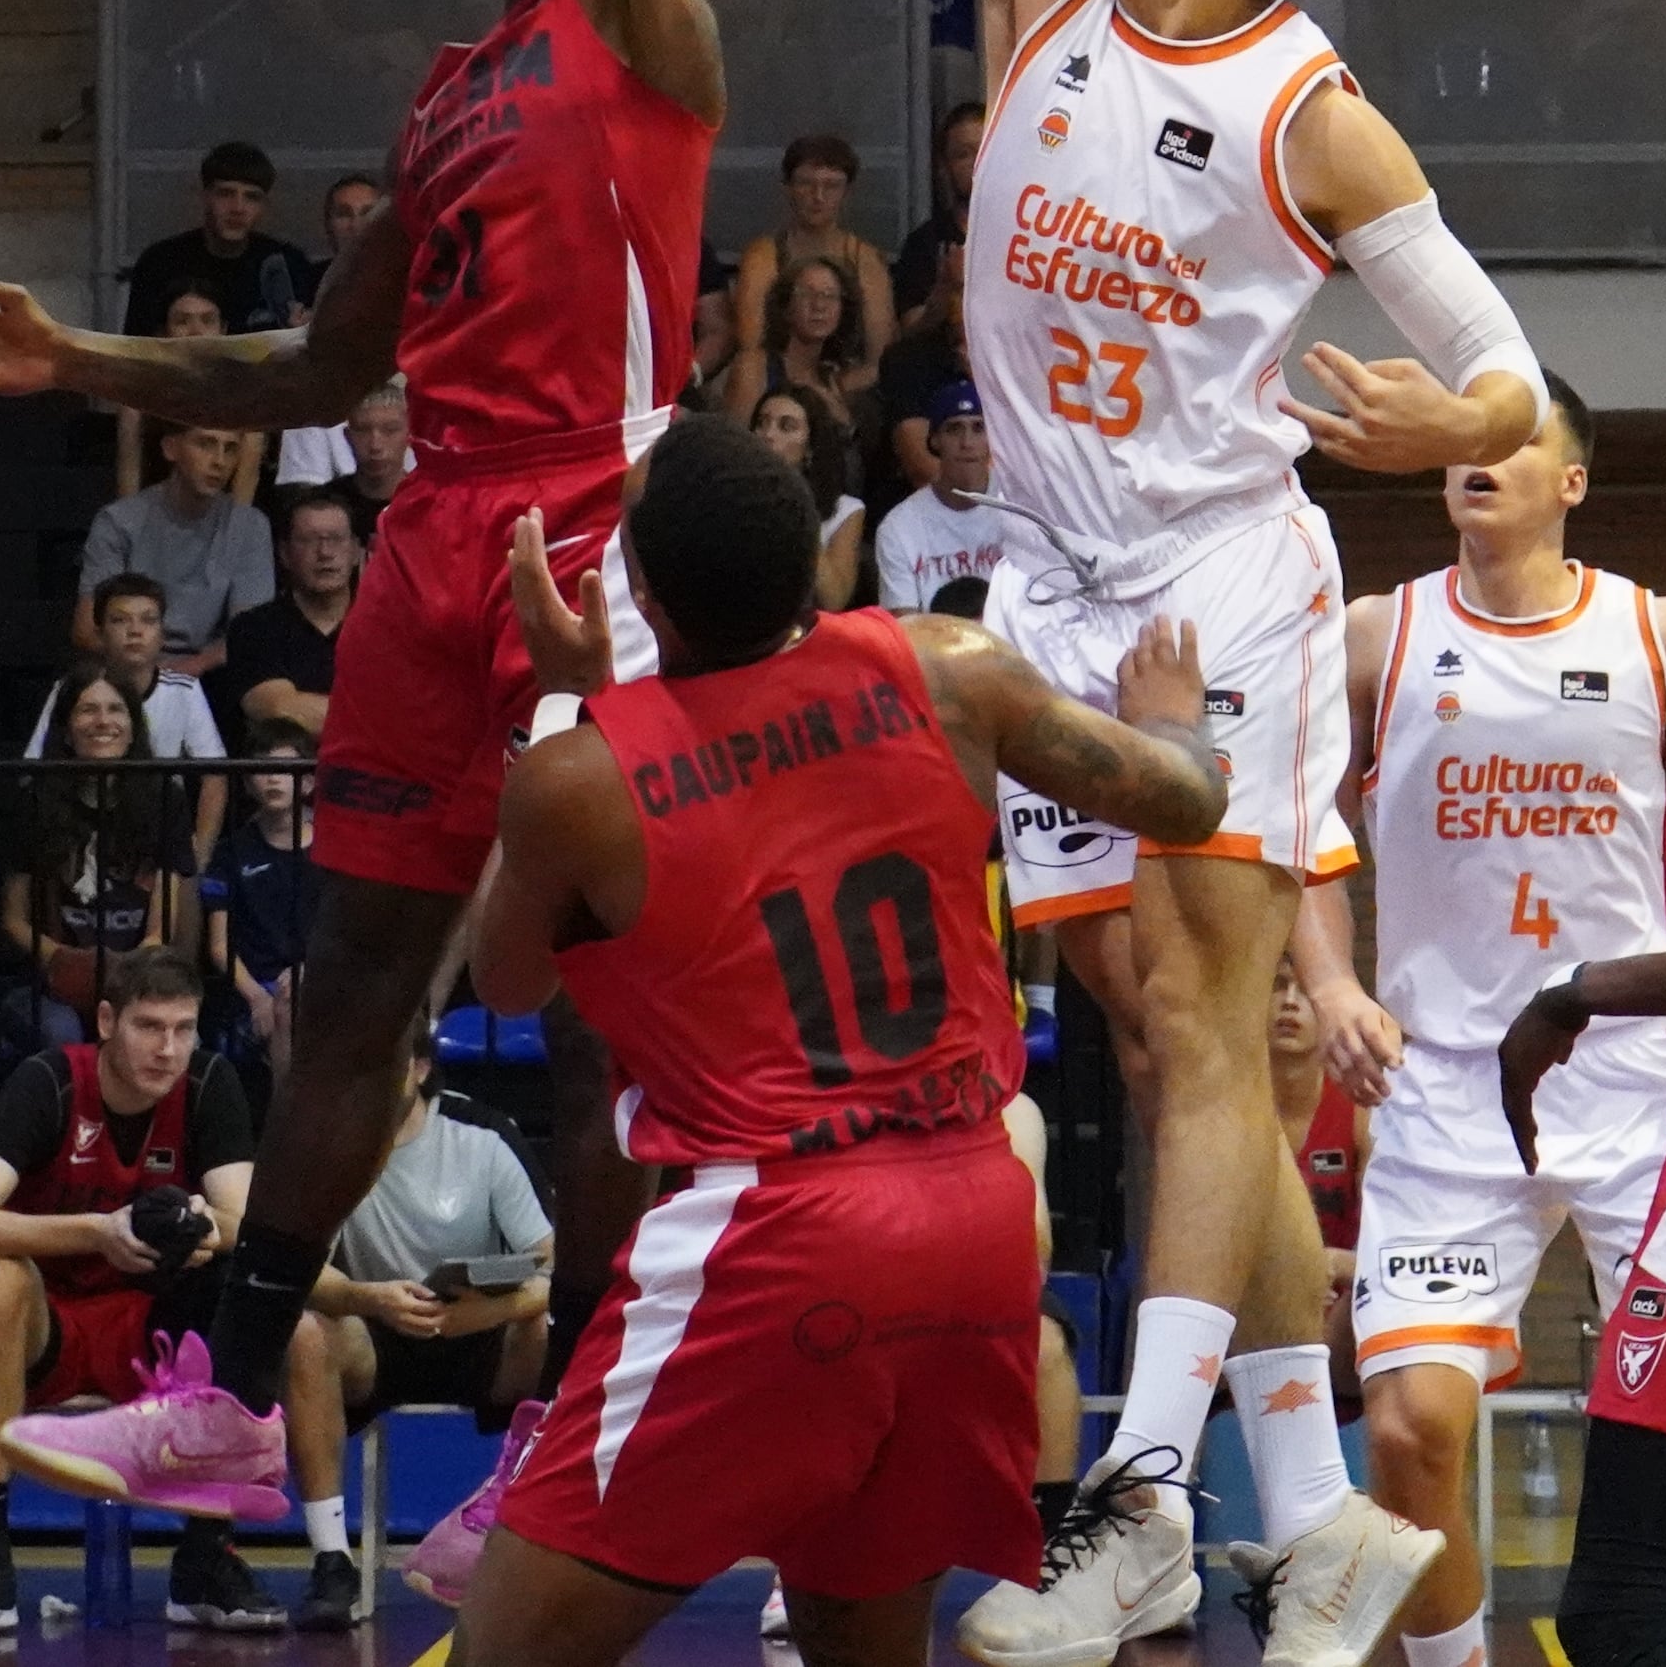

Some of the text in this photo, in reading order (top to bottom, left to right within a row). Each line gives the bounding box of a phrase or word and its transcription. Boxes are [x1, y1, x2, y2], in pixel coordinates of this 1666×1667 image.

[1016, 184, 1206, 280] Cultura del
[1006, 234, 1201, 326] Esfuerzo
[1048, 327, 1149, 438] 23
[634, 682, 929, 817] CAUPAIN JR.
[1436, 754, 1619, 795] Cultura del
[1436, 797, 1619, 840] Esfuerzo
[1510, 872, 1559, 949] 4
[759, 851, 947, 1089] 10
[1389, 1256, 1488, 1277] PULEVA
[1633, 1299, 1658, 1314] acb
